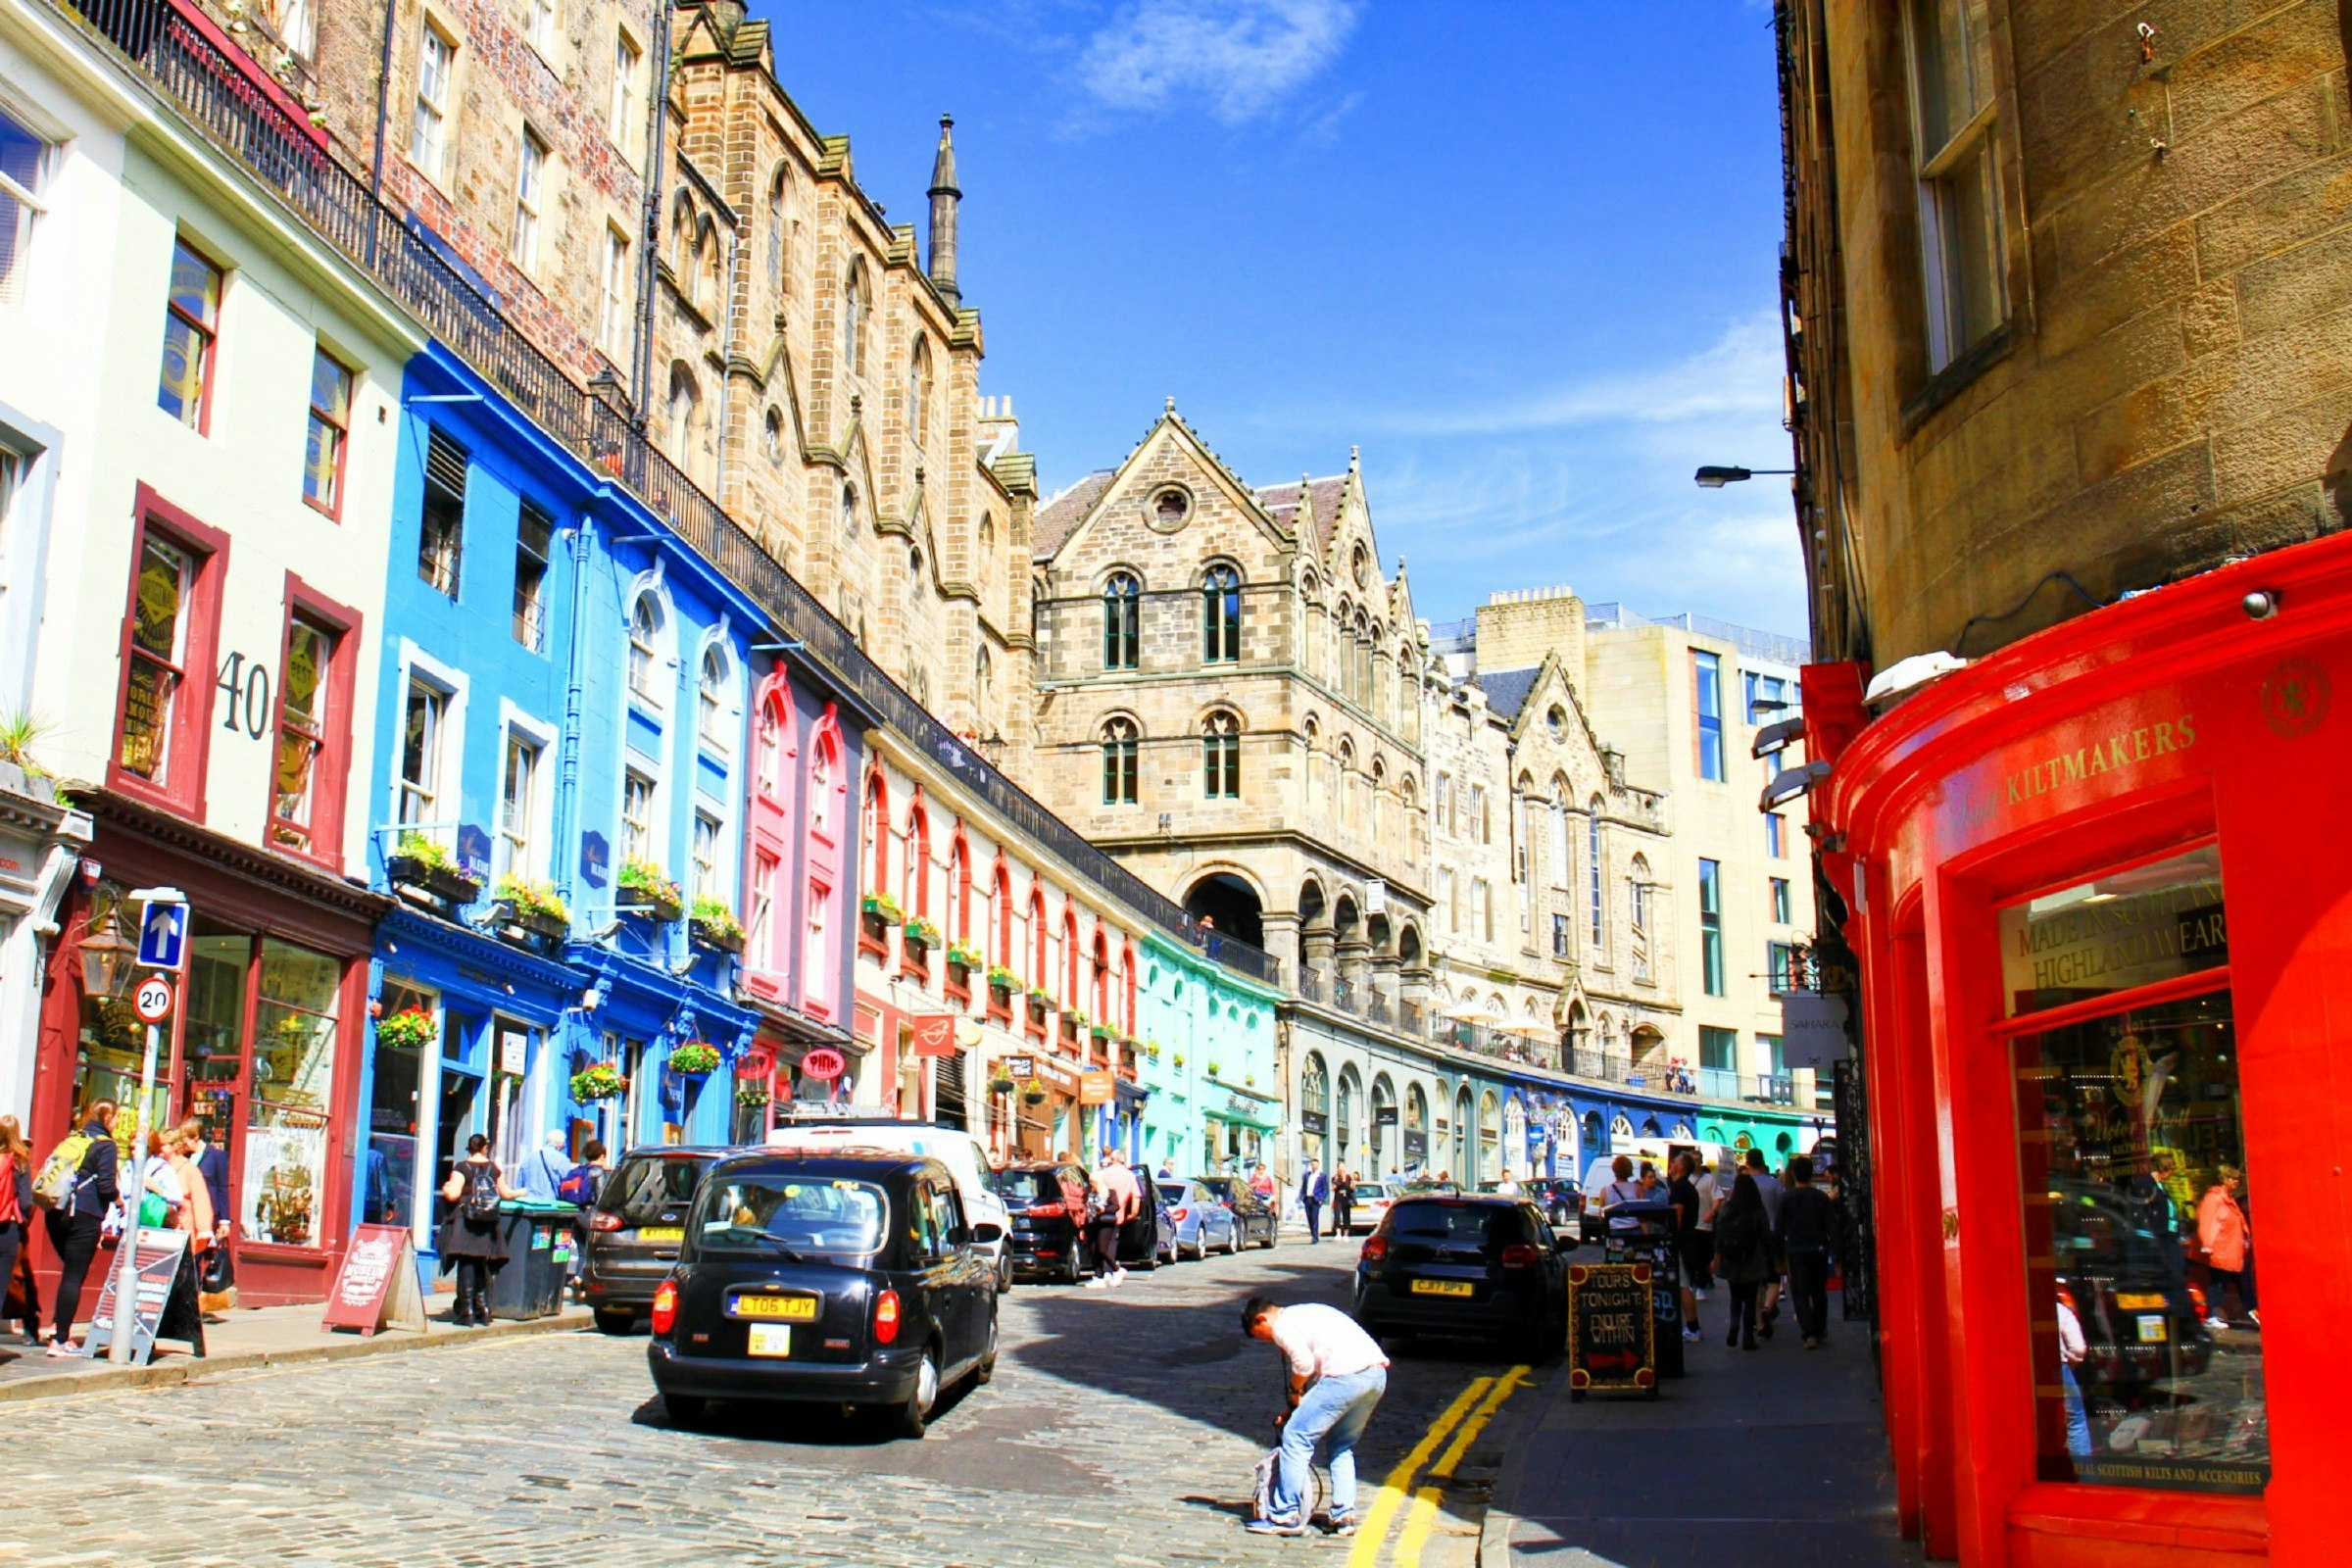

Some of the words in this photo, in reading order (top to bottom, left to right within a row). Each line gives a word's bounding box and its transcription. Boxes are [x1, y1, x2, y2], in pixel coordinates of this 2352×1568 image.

[217, 651, 270, 741] 40
[2007, 713, 2196, 807] KILTMAKERS
[2019, 917, 2081, 957] MADE
[2033, 933, 2150, 990] HIGHLAND
[2150, 913, 2228, 957] WEAR
[141, 992, 167, 1008] 20
[1788, 1020, 1840, 1030] SAHARA
[1590, 1274, 1631, 1289] TOURS
[741, 1298, 779, 1312] LT06
[783, 1298, 811, 1314] TJY
[1590, 1326, 1636, 1344] WITHIN
[2097, 1463, 2143, 1479] SCOTTISH
[2144, 1465, 2172, 1481] KILTS
[2174, 1467, 2196, 1482] AND
[2197, 1468, 2262, 1485] ACCESORIES
